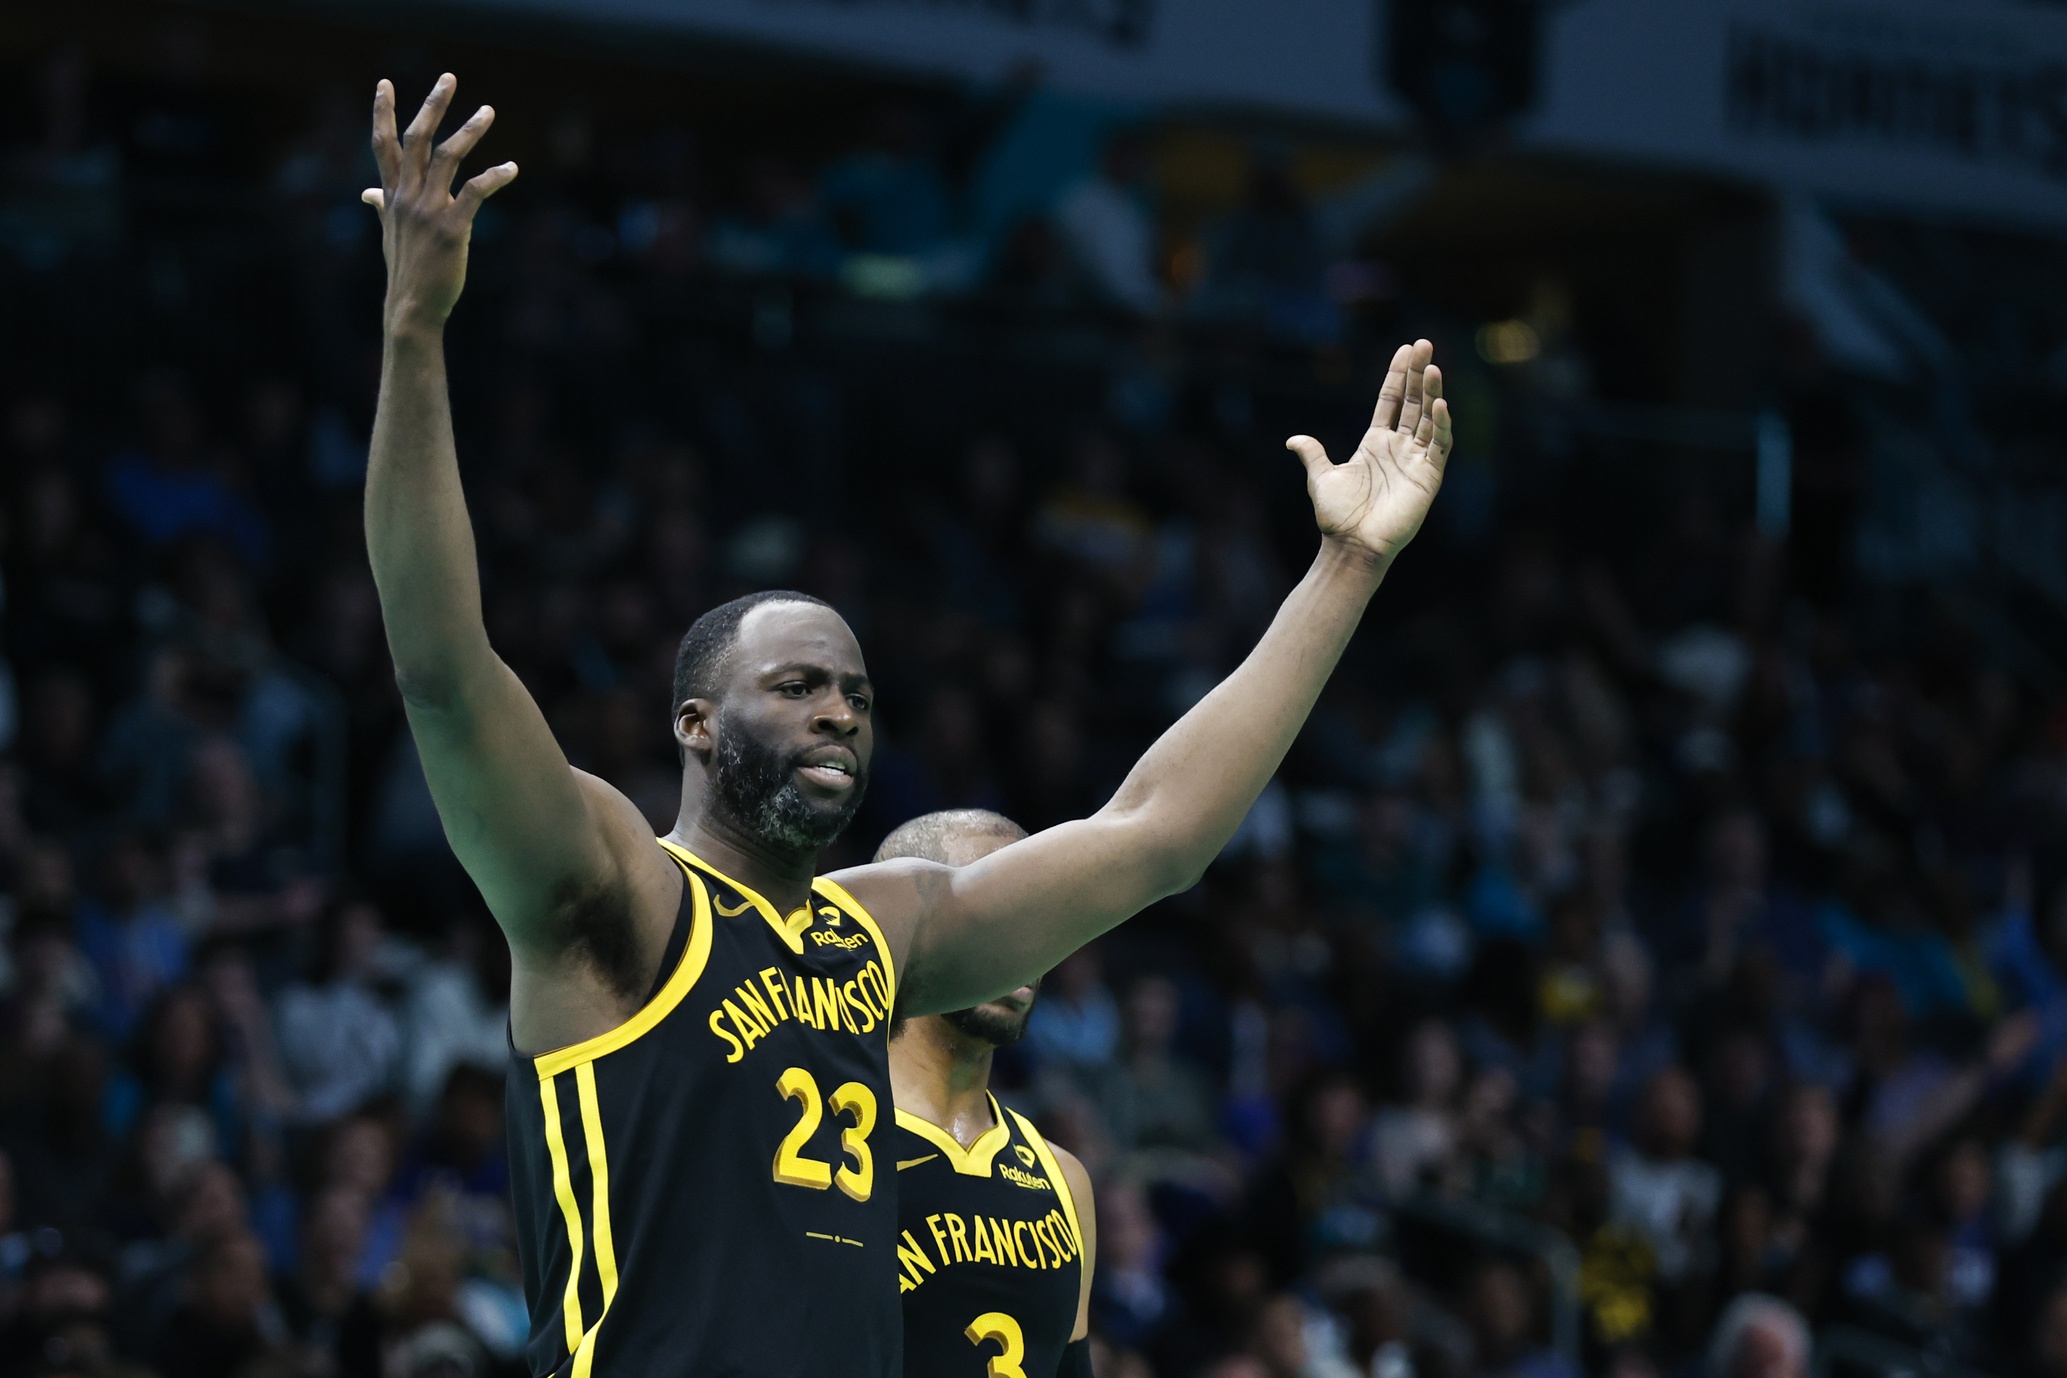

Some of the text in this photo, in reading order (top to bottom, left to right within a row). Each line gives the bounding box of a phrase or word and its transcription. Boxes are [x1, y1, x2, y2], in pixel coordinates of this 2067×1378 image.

[708, 978, 780, 1064] SAN
[772, 1066, 878, 1203] 23
[925, 1208, 1078, 1270] FRANCISCO
[964, 1312, 1029, 1378] 3
